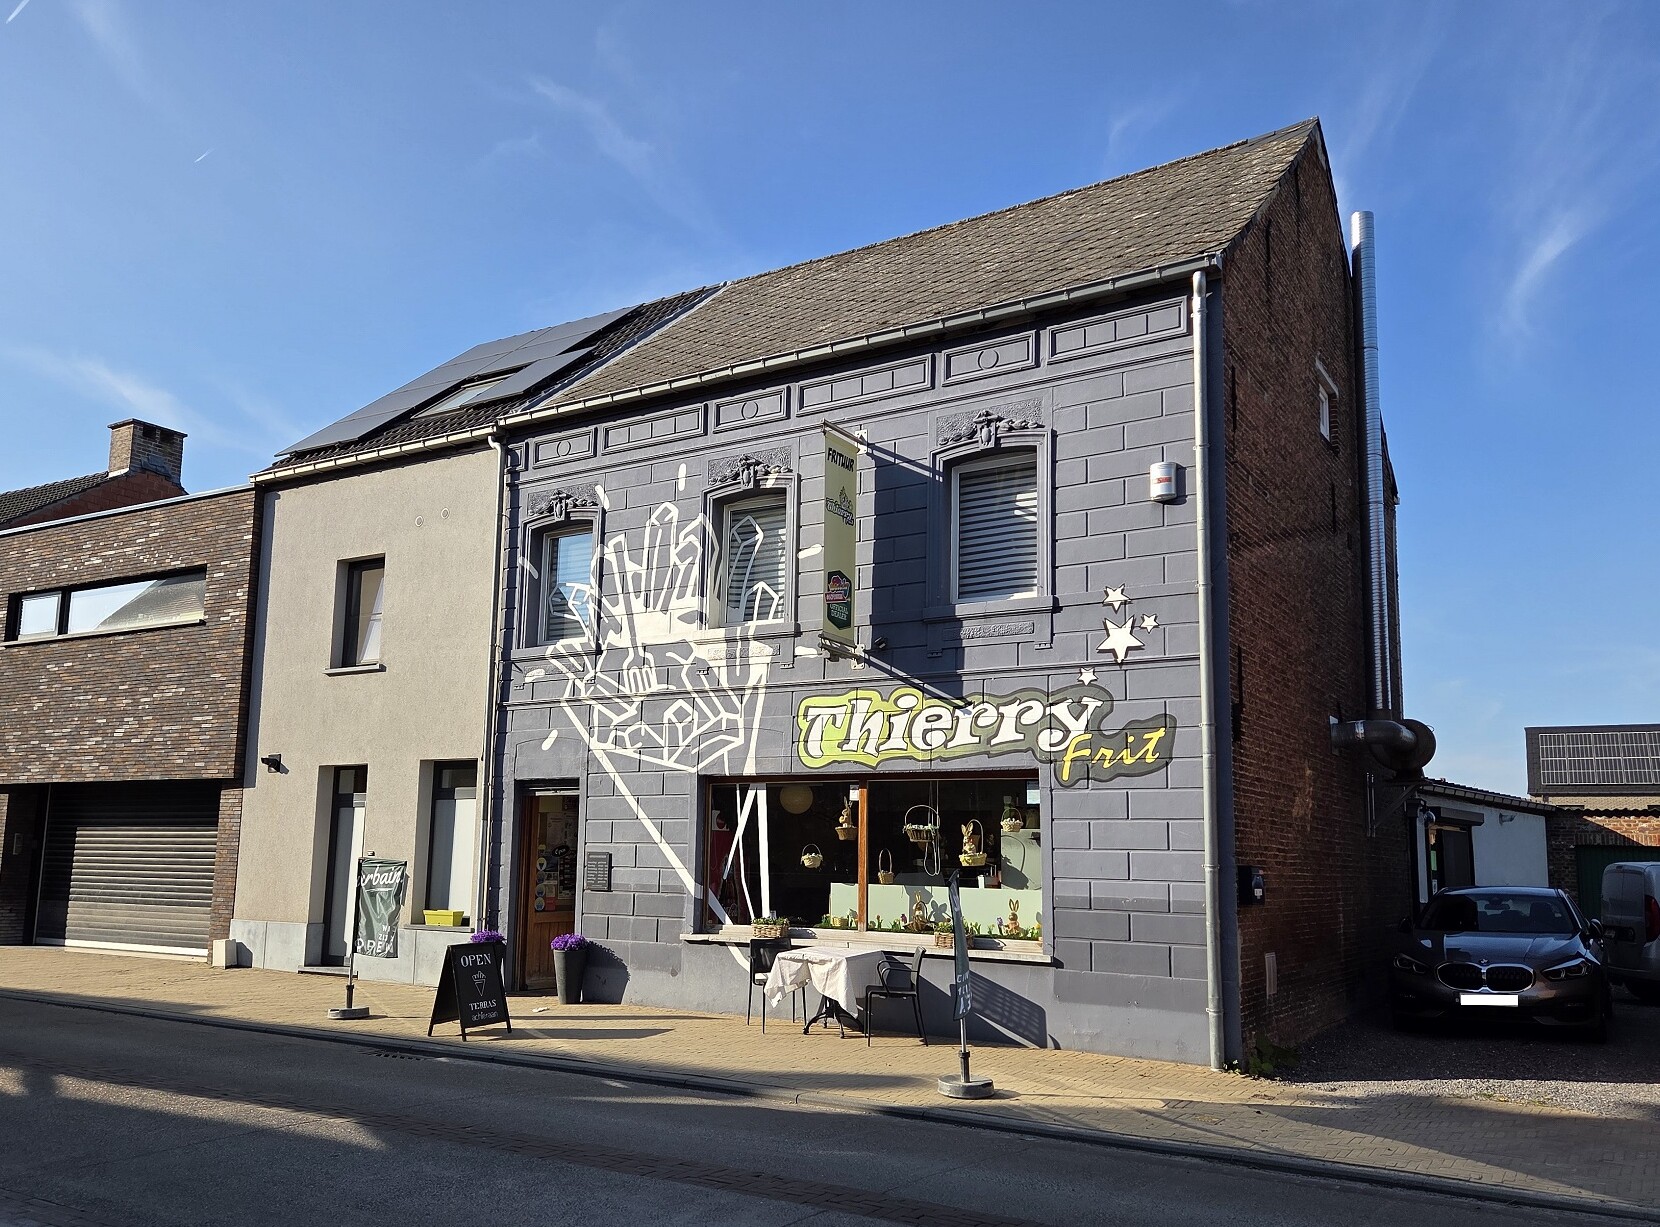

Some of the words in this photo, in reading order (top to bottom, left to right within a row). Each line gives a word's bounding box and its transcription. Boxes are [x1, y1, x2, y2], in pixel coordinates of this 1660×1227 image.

[827, 447, 855, 472] FRITUUR
[803, 693, 1104, 759] Thierry
[460, 953, 492, 968] OPEN
[469, 999, 497, 1011] TERRAS
